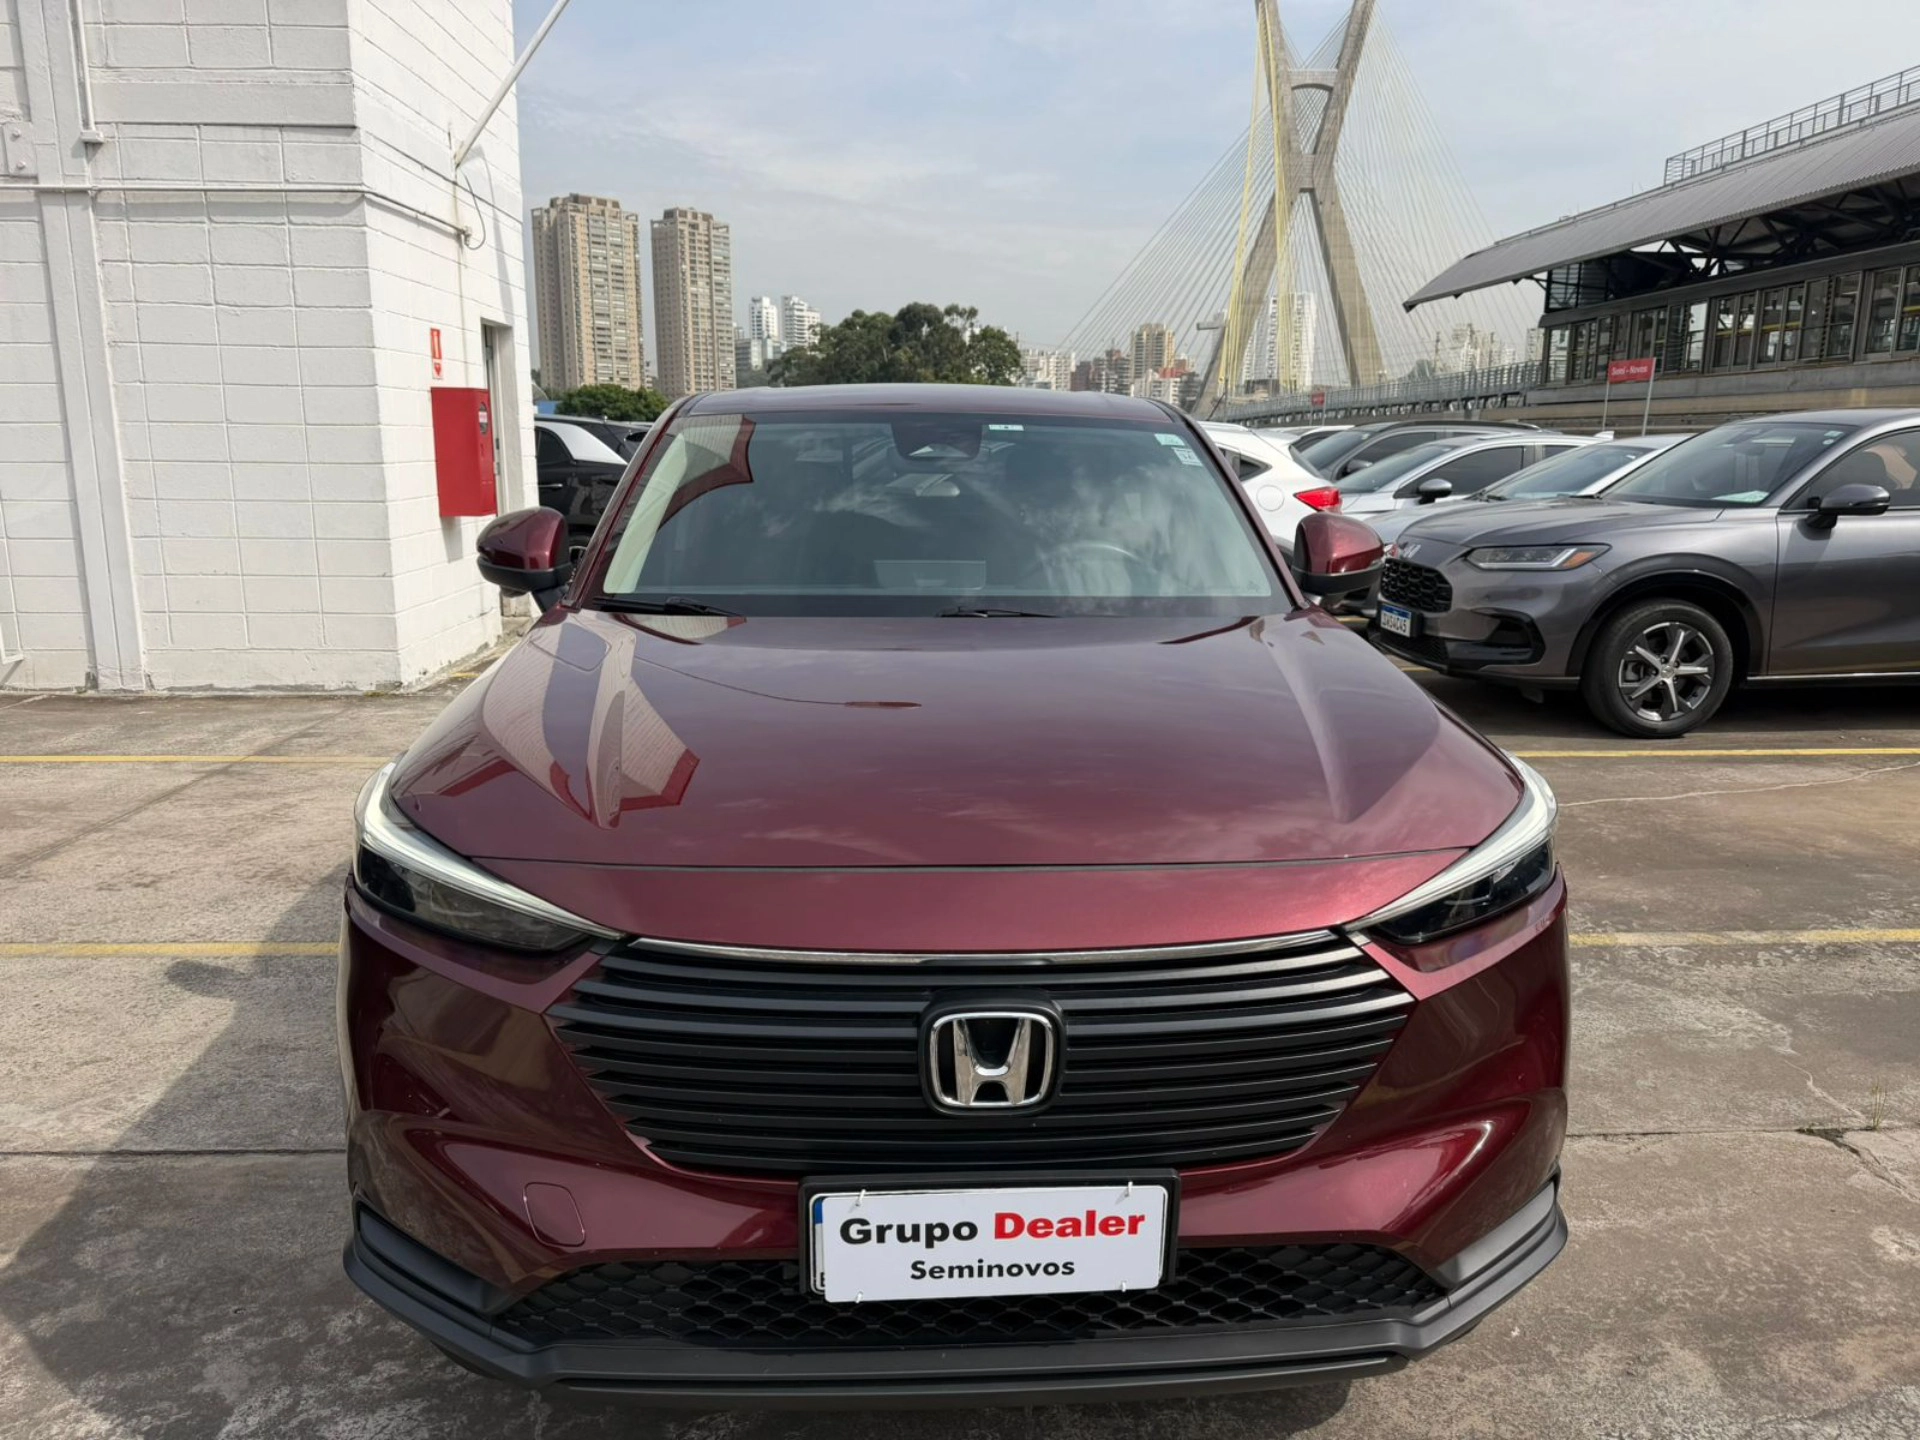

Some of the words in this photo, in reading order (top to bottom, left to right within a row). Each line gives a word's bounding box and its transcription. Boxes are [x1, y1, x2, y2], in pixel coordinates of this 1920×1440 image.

[839, 1217, 979, 1249] Grupo
[994, 1209, 1146, 1240] Dealer
[910, 1258, 1075, 1280] Seminovos
